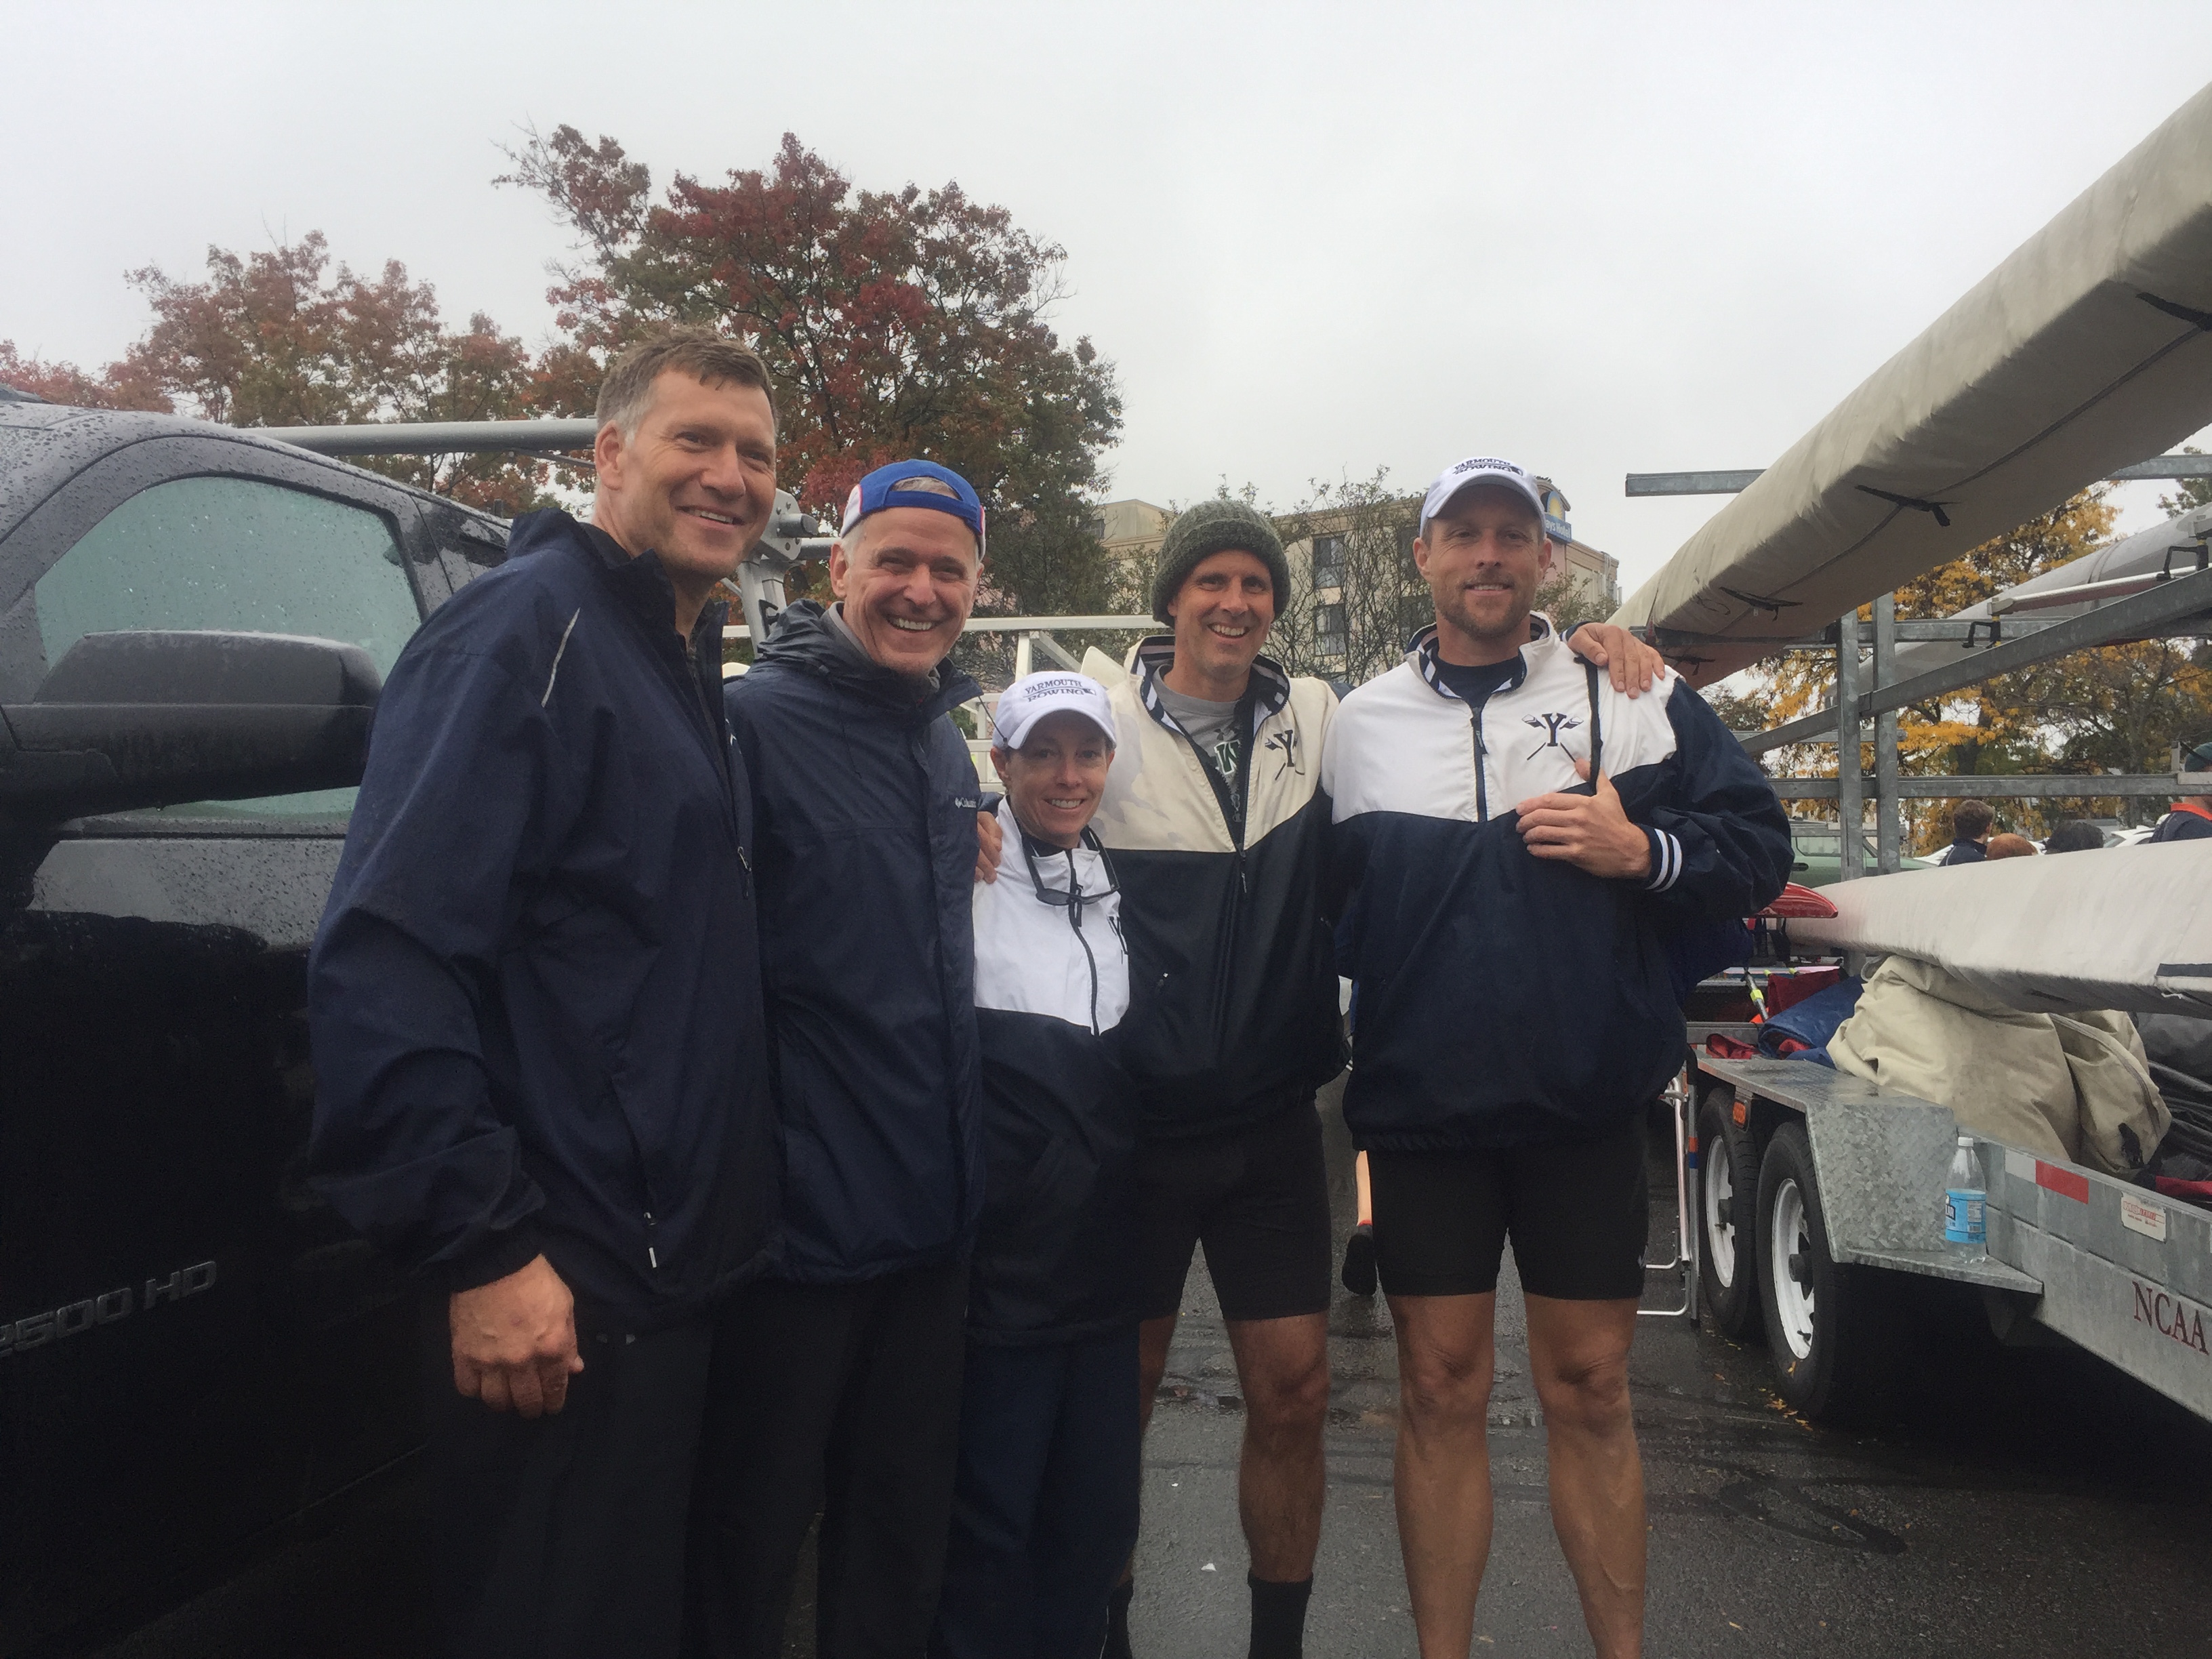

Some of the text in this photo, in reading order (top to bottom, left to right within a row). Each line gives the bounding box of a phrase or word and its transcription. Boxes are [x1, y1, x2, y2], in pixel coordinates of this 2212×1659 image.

[1545, 519, 1571, 538] ays Hotel
[1025, 679, 1083, 694] YARMOUTH
[1027, 689, 1084, 702] ROWING
[1541, 712, 1567, 747] Y
[1273, 729, 1294, 767] Y
[143, 1261, 217, 1310] HD
[2132, 1280, 2209, 1355] NCAA
